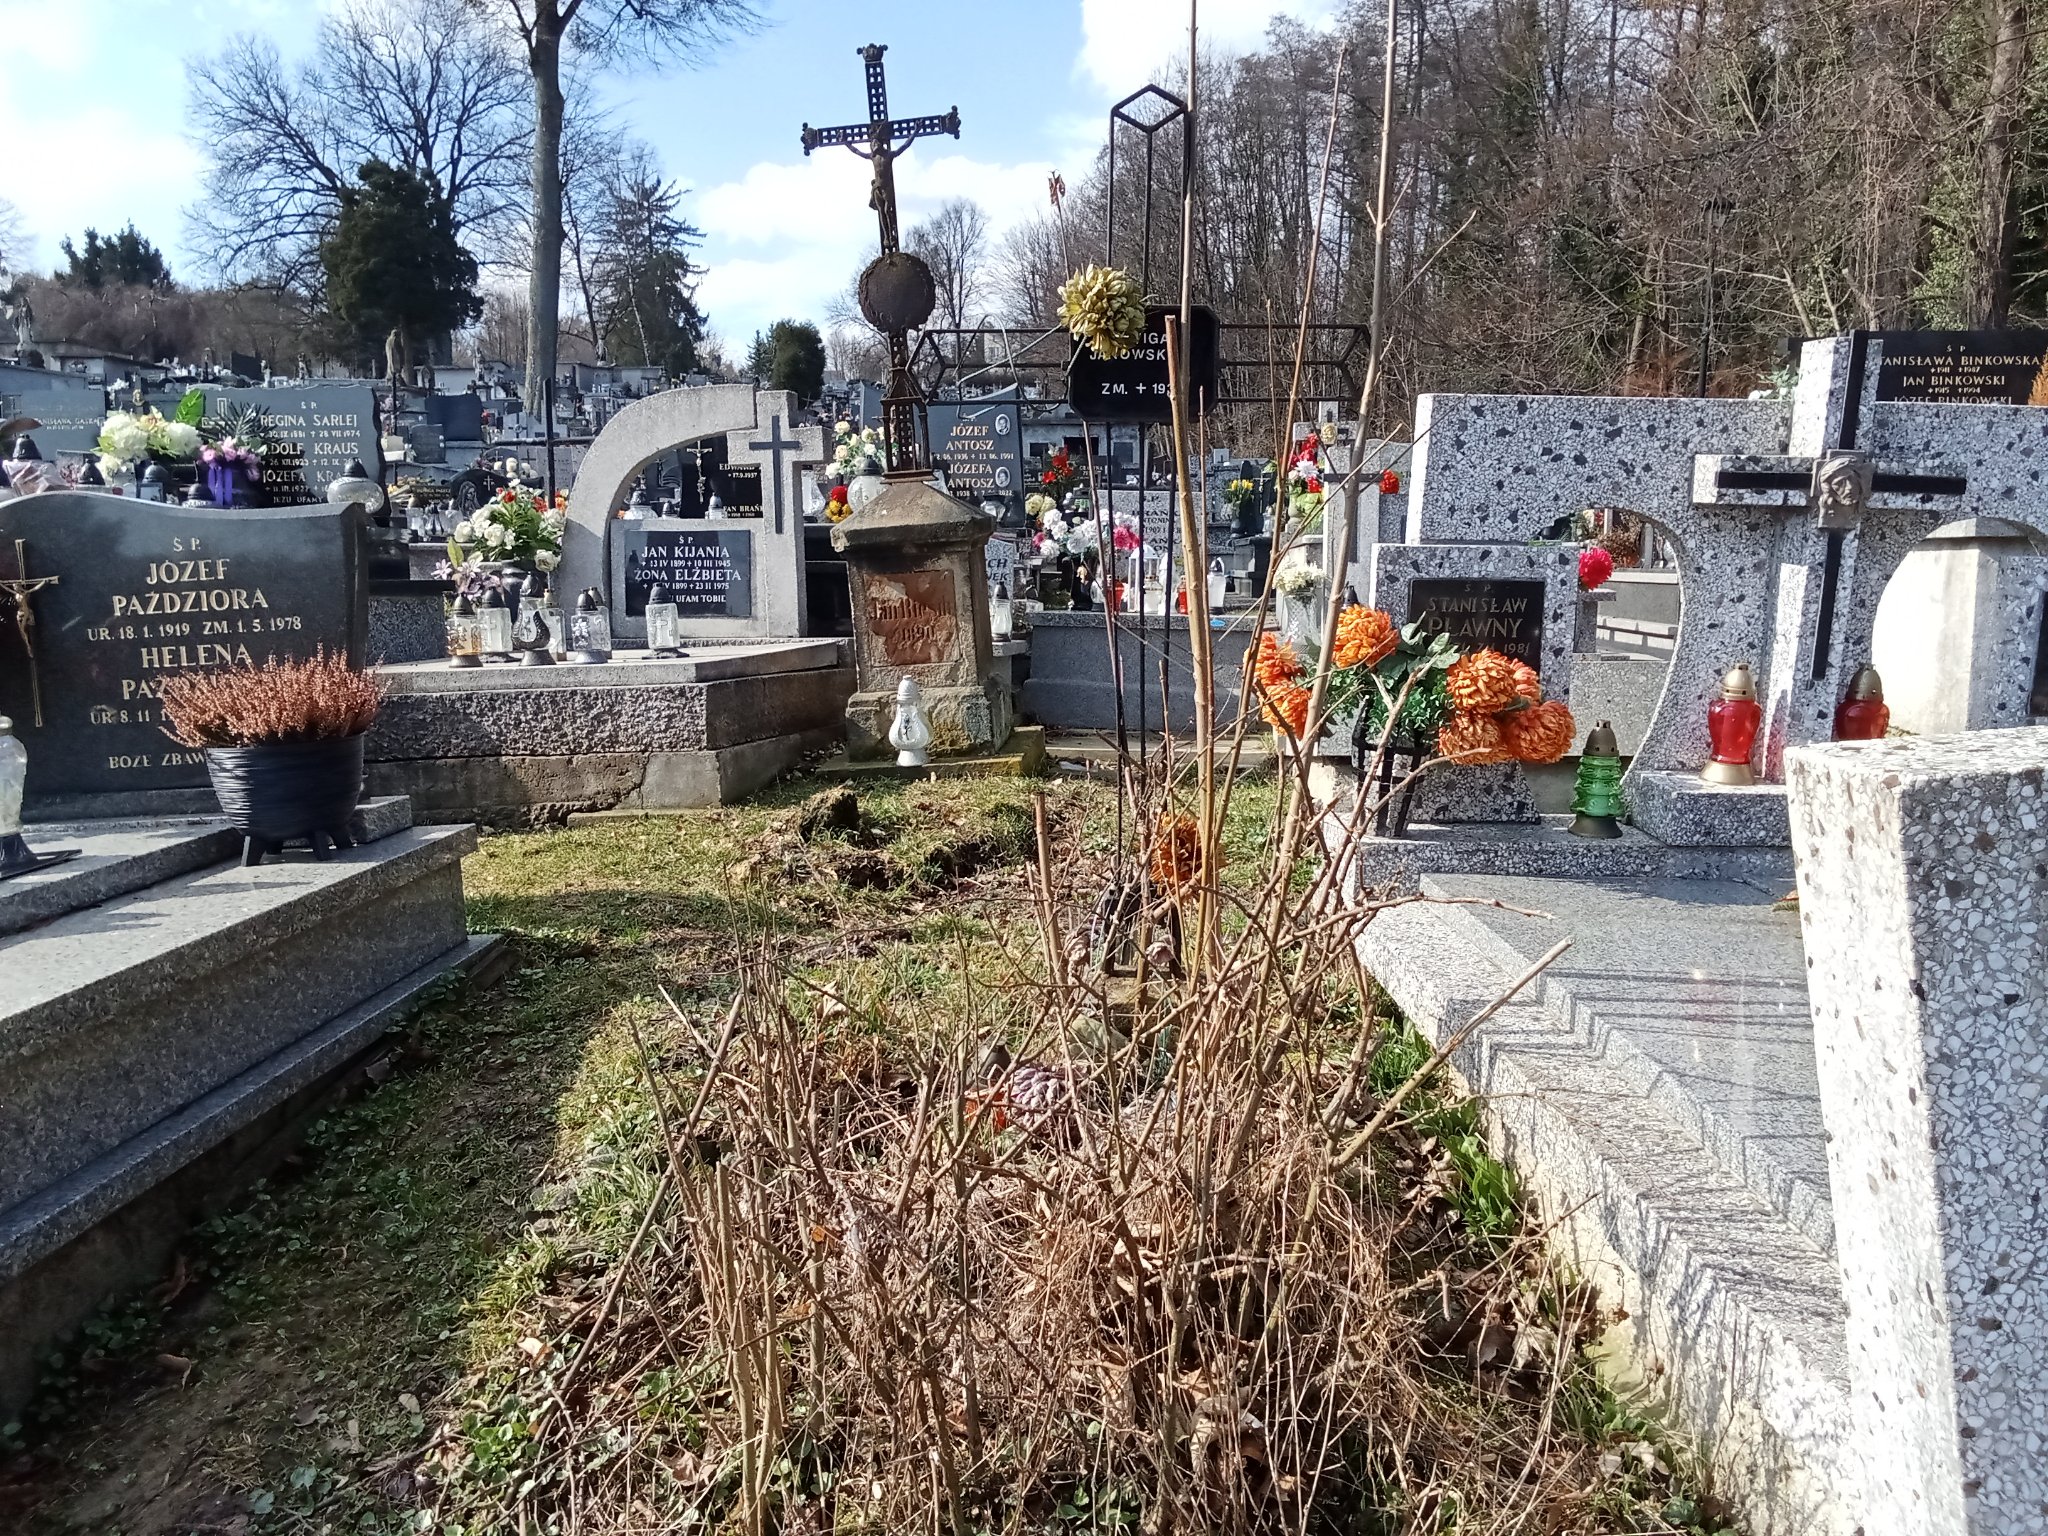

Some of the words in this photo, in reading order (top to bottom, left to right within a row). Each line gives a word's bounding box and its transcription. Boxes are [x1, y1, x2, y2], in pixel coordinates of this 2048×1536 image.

[1882, 356, 1953, 366] ANISŁAWA
[1961, 355, 2040, 366] BINKOWSKA
[1903, 375, 1925, 387] JAN
[1931, 375, 2005, 386] BINKOWSKI
[260, 414, 306, 427] REGINA
[313, 414, 358, 427] SARLEJ
[950, 423, 989, 437] JÓZEF
[268, 443, 304, 455] DOLF
[314, 442, 359, 455] KRAUS
[945, 439, 995, 451] ANTOSZ
[947, 462, 993, 474] JÓZEFA
[947, 478, 995, 489] ANTOSZ
[642, 546, 667, 558] JAN
[674, 546, 730, 558] KIJANIA
[146, 559, 230, 585] JÓZEF
[634, 568, 668, 581] ŻONA
[675, 567, 742, 581] ELŻBIETA
[112, 587, 269, 617] PAŹDZIORA
[676, 595, 699, 603] UFAM
[1427, 596, 1528, 613] STANISŁAW
[87, 627, 115, 641] UR.
[159, 622, 190, 637] 1919
[202, 620, 233, 635] ZM.
[269, 615, 302, 632] 1978
[1427, 615, 1524, 638] PŁAWNY
[141, 643, 251, 668] HELENA
